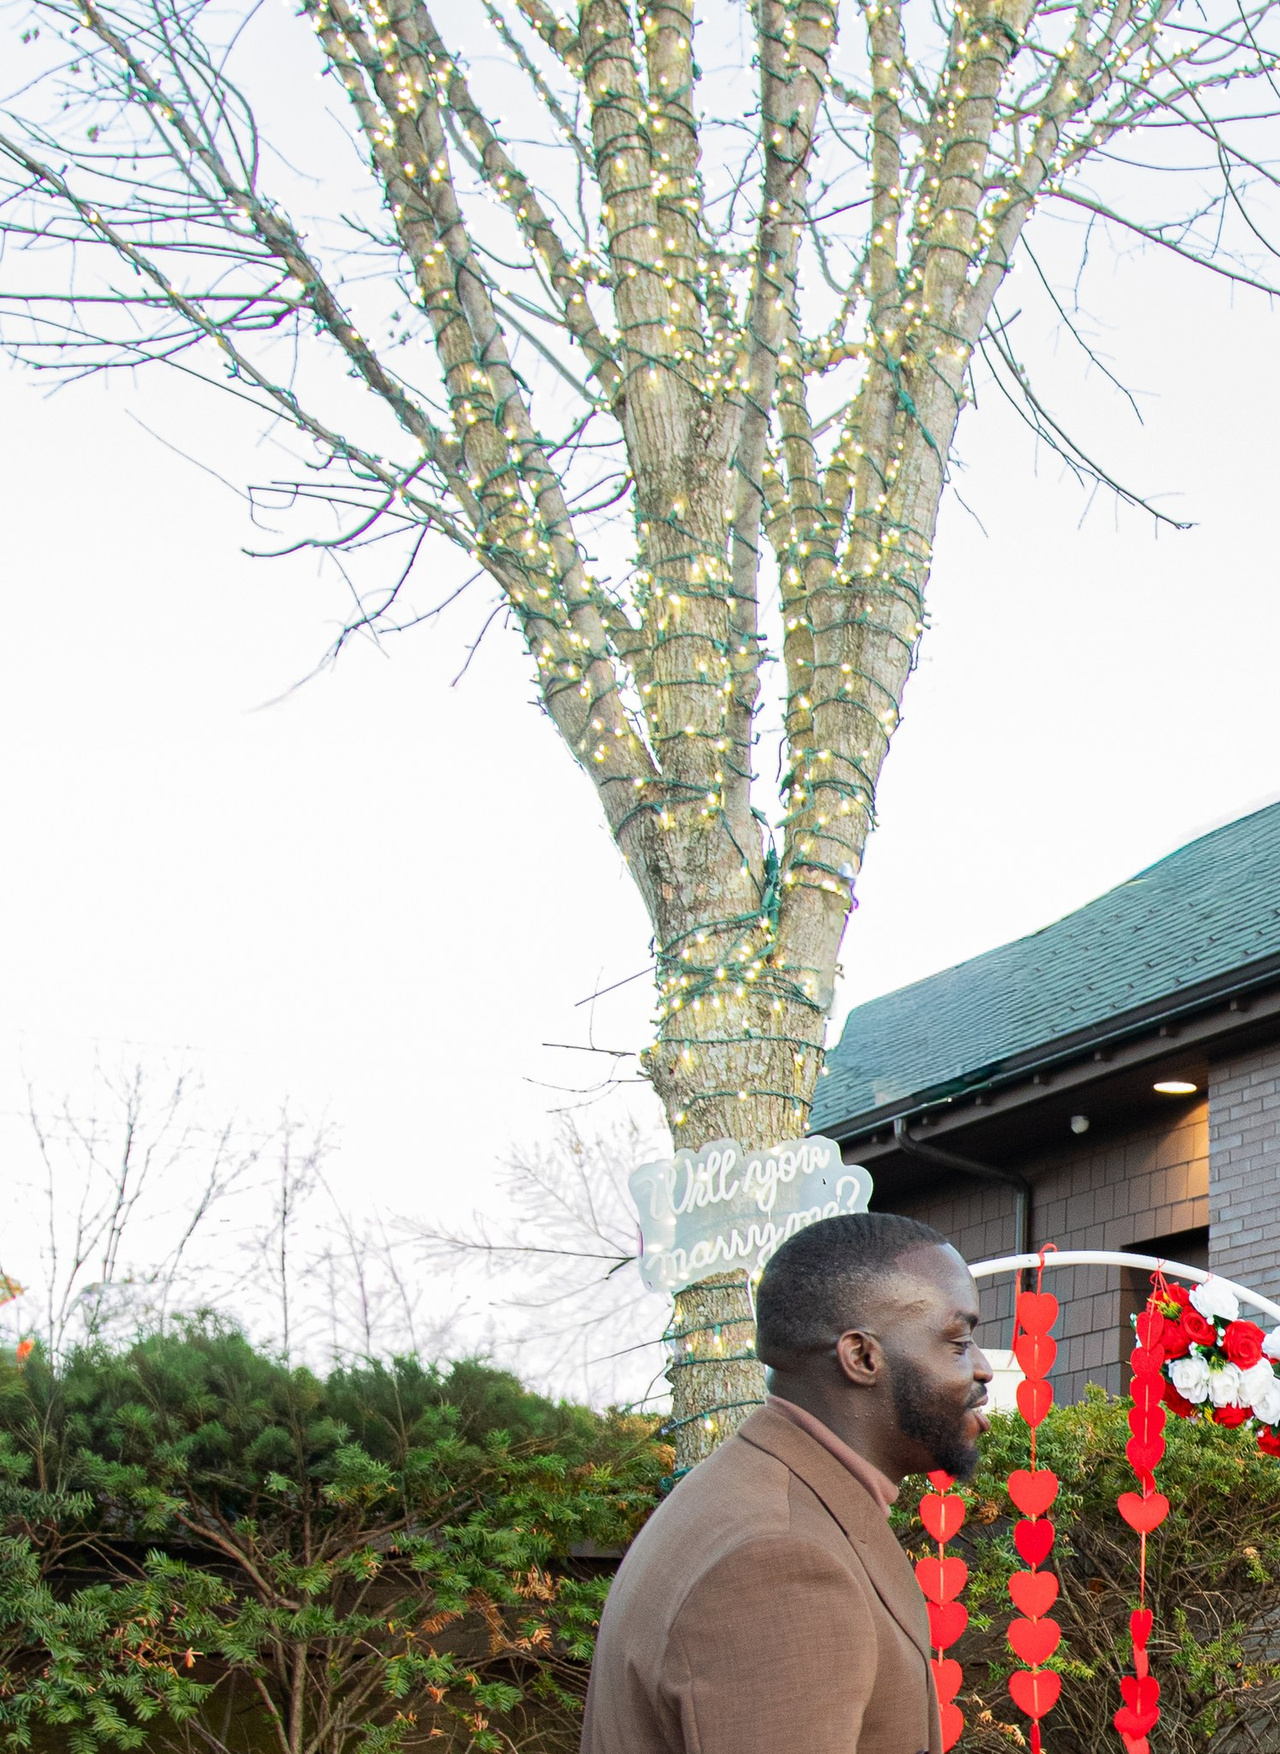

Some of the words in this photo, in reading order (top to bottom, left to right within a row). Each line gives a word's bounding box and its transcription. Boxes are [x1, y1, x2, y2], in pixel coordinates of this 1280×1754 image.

[636, 1148, 740, 1220] Will
[742, 1145, 831, 1212] you
[645, 1222, 785, 1284] marry
